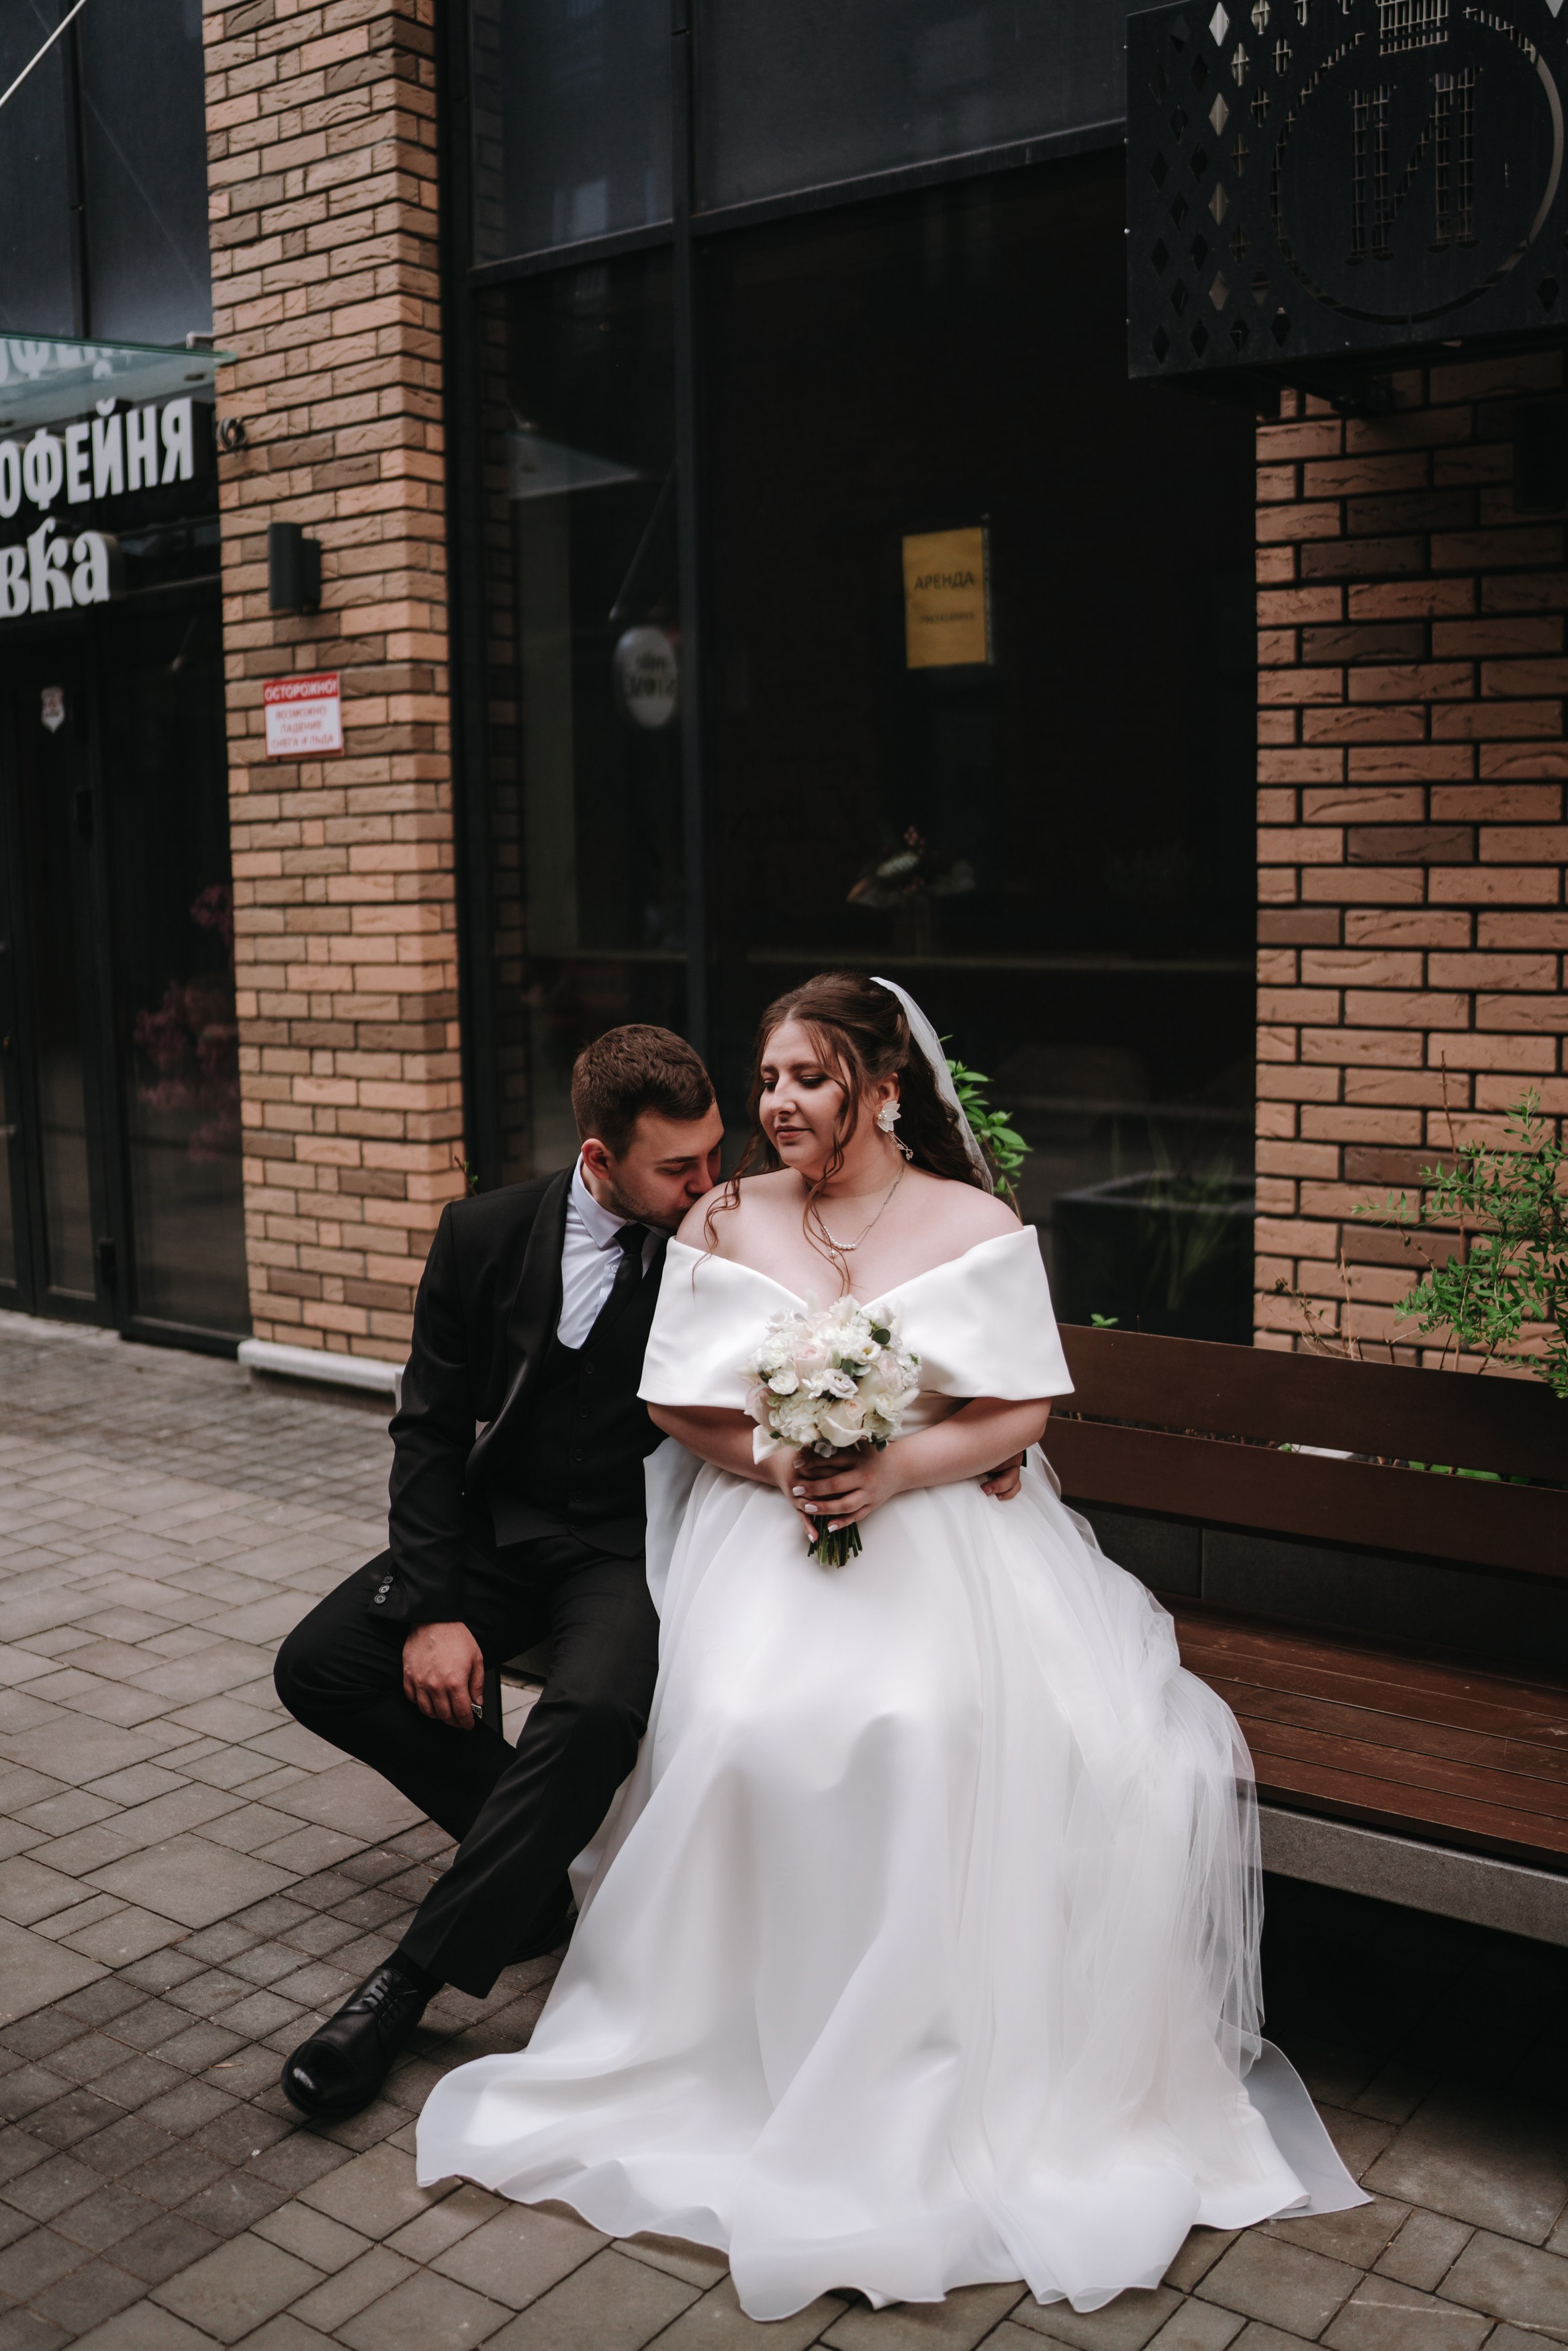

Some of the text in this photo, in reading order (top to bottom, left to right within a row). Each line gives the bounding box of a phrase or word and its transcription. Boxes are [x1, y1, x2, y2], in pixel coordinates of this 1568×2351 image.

[0, 396, 194, 519] ОФЕЙНЯ
[914, 571, 975, 590] АРЕНДА
[265, 678, 336, 701] ОСТОРОЖНО!
